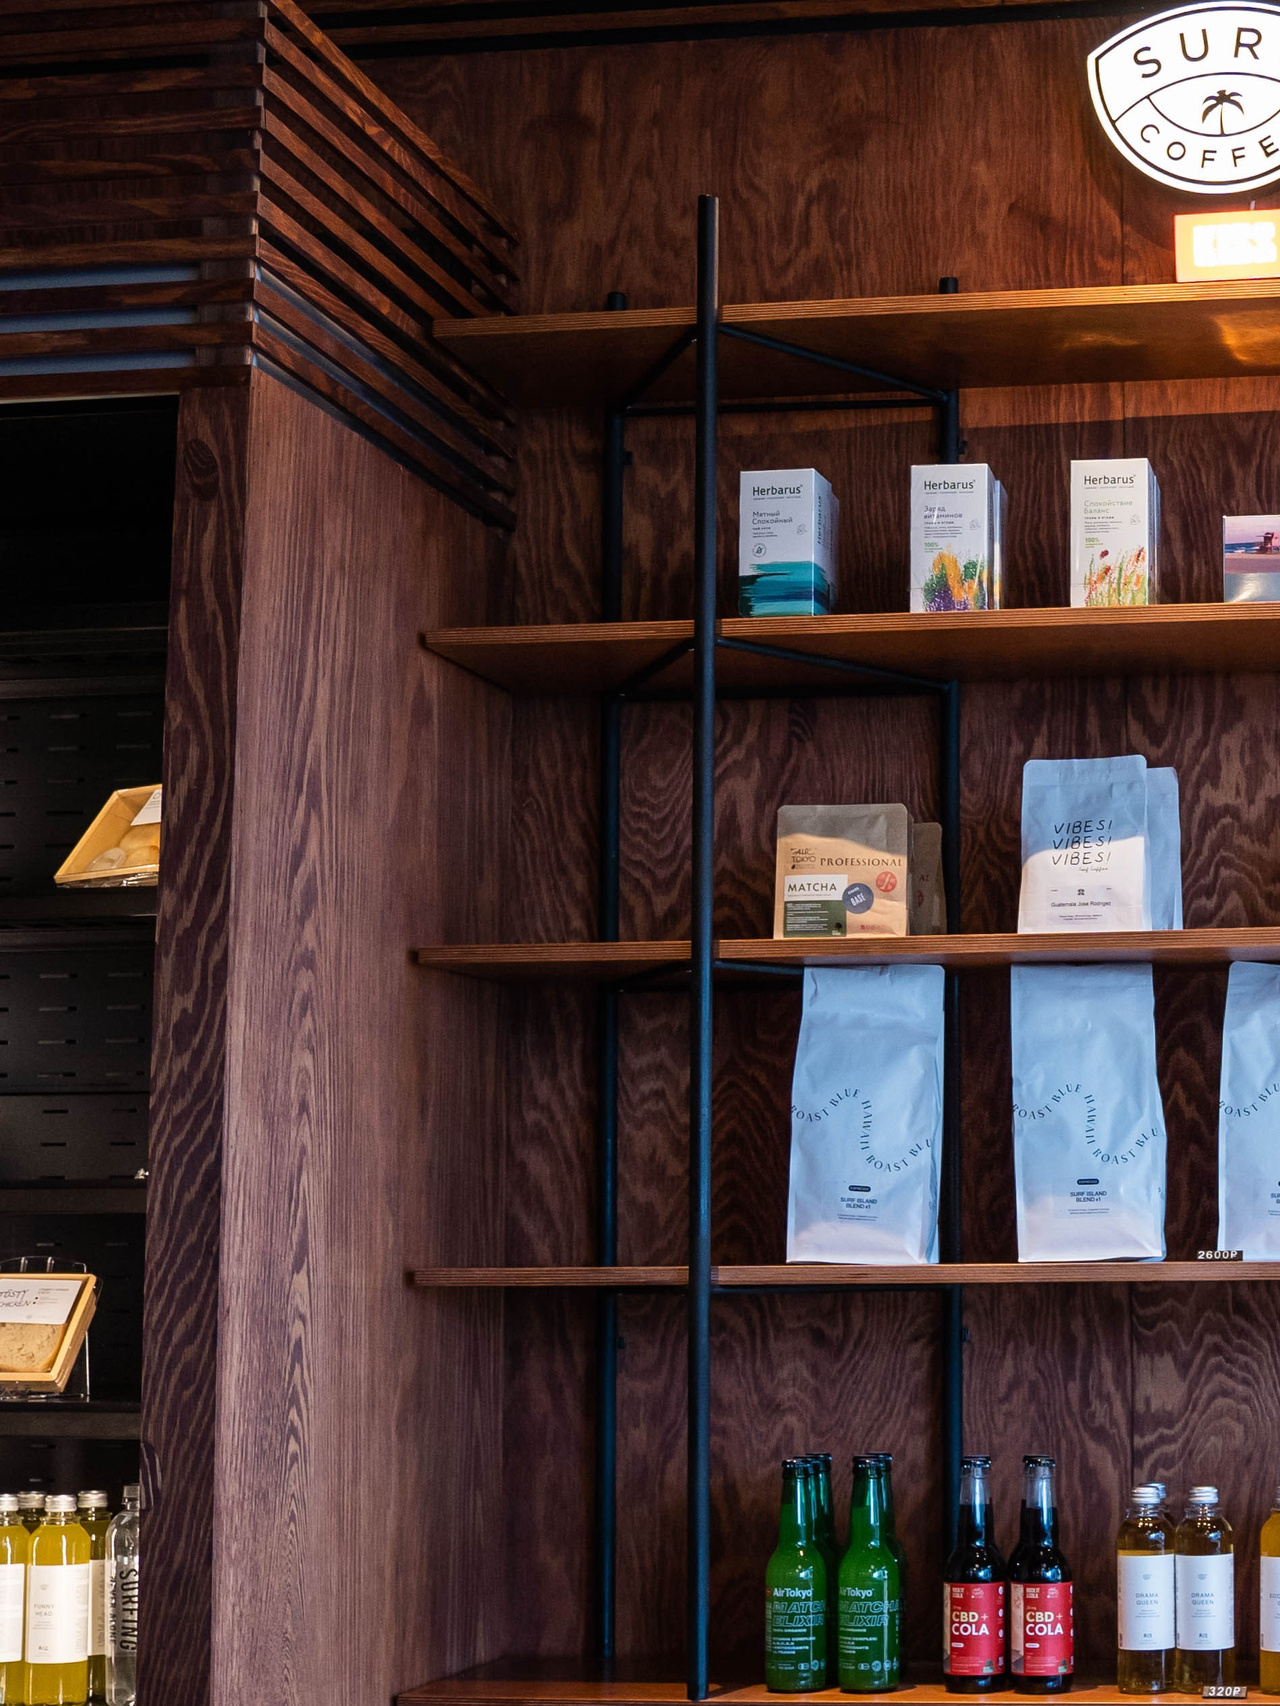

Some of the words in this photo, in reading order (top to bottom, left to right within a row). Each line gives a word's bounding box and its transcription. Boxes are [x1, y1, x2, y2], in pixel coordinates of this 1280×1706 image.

[924, 480, 974, 490] Herbarus
[1084, 474, 1135, 485] Herbarus
[752, 485, 802, 496] Herbarus
[752, 510, 780, 518] Мятный
[752, 517, 793, 525] Спокойный
[1054, 819, 1112, 835] VIBES!
[1052, 836, 1112, 850] VIBES!
[1052, 852, 1112, 866] VIBES!
[788, 883, 837, 892] MATCHA
[850, 892, 866, 906] BASE
[829, 1088, 861, 1107] BLUE
[860, 1100, 873, 1150] HAWAII
[1052, 1083, 1082, 1103] BLUE
[1084, 1094, 1096, 1144] HAWAII
[1092, 1148, 1136, 1165] ROAST
[1136, 1128, 1159, 1147] BLU
[909, 1138, 932, 1157] BLU
[866, 1154, 909, 1173] ROAST
[773, 1588, 812, 1599] AirTokyo
[840, 1587, 874, 1599] AirTokyo
[119, 1568, 138, 1650] SURFING
[773, 1600, 825, 1613] MATC
[773, 1614, 824, 1626] ELIXIR
[840, 1614, 889, 1626] ELIXIR
[952, 1611, 979, 1622] CBD
[1026, 1611, 1054, 1622] CBD
[952, 1623, 990, 1635] COLA
[1026, 1623, 1064, 1635] COLA
